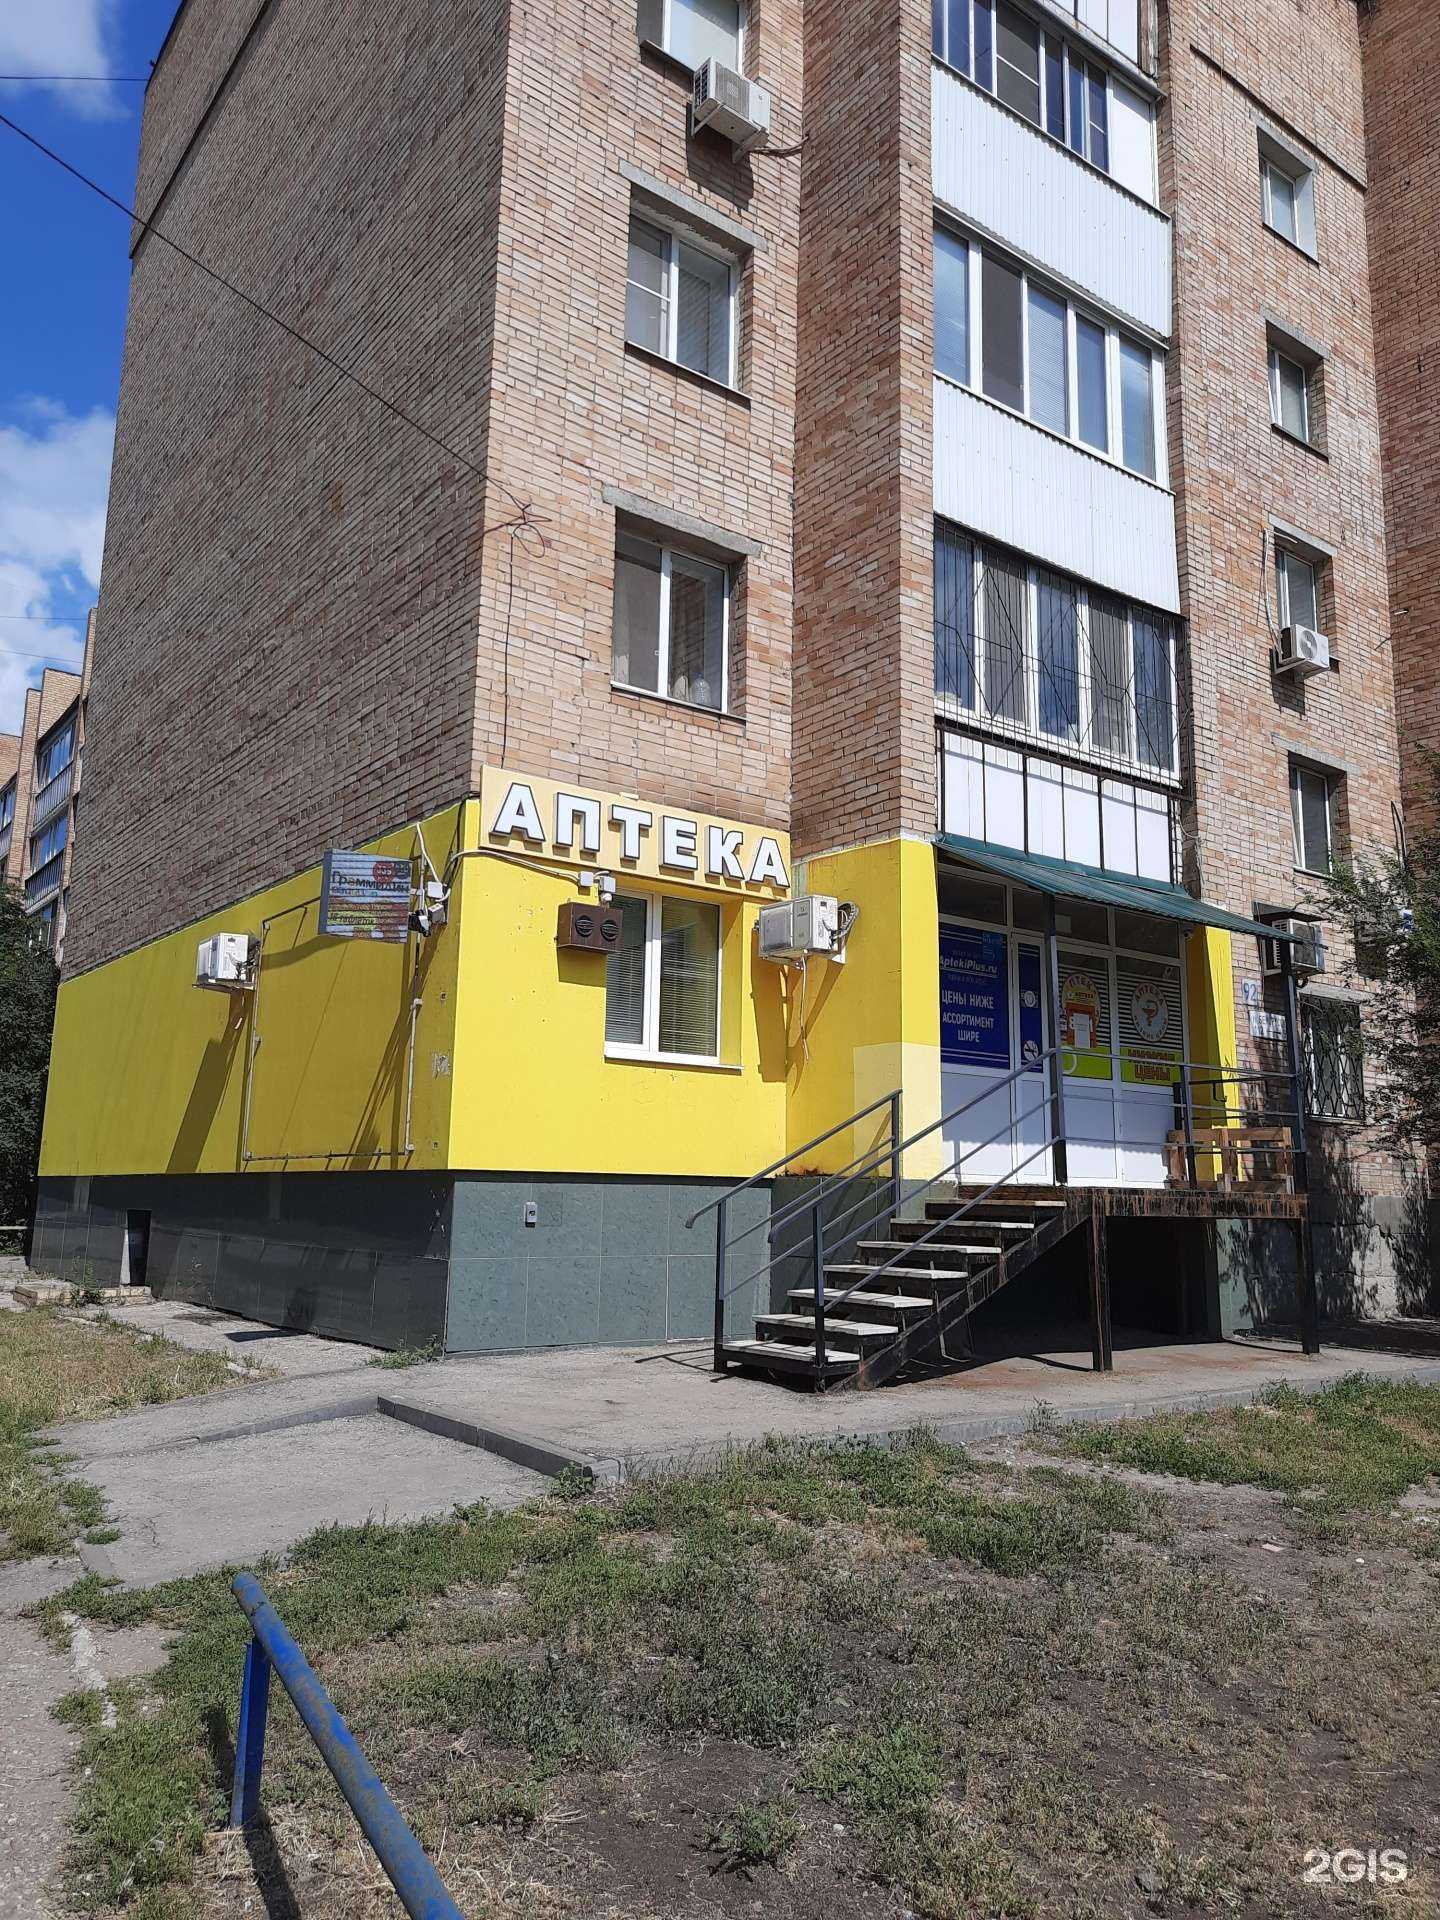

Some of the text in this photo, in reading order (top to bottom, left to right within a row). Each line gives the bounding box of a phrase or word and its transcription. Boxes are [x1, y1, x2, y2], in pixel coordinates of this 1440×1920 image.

[491, 782, 791, 888] АПТЕКА
[941, 989, 994, 1009] ЦЕНЫ НИЖЕ
[1243, 982, 1257, 1001] 92
[942, 1012, 994, 1029] АССОРТИМЕНТ
[957, 1029, 980, 1042] ШИРЕ
